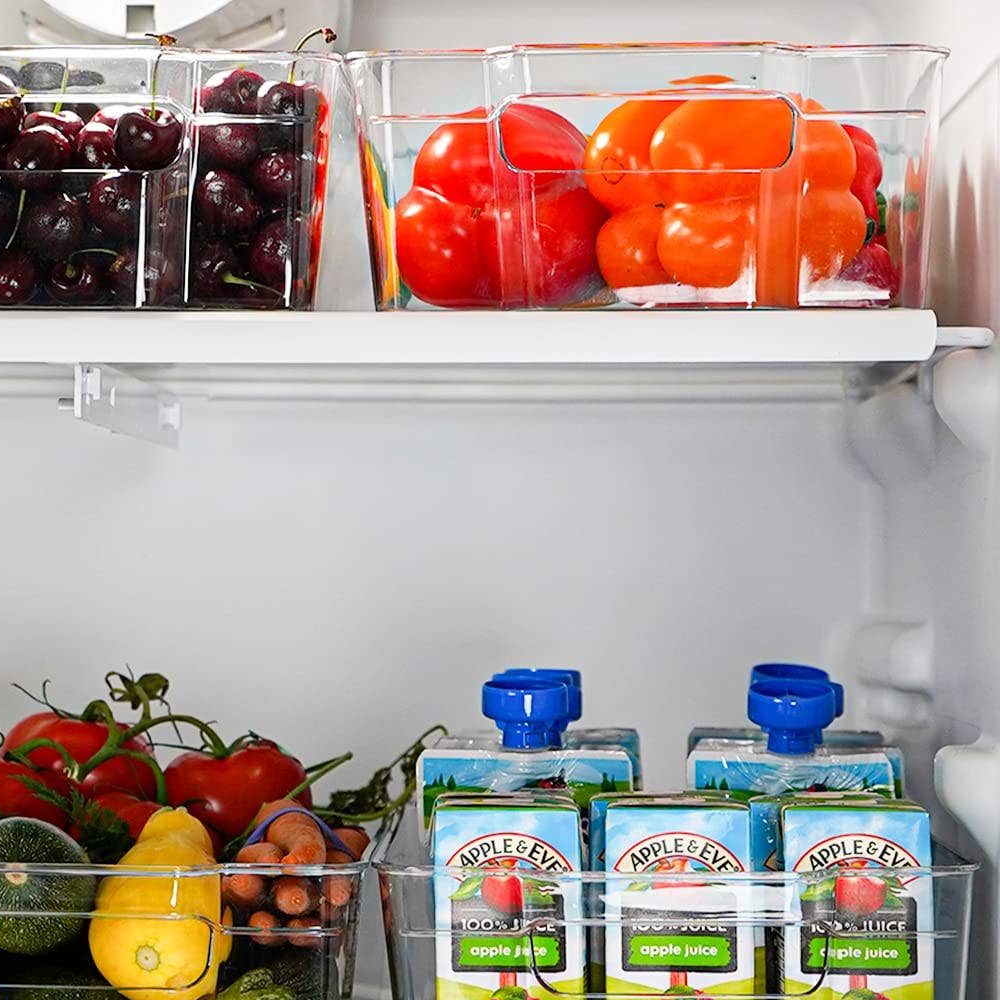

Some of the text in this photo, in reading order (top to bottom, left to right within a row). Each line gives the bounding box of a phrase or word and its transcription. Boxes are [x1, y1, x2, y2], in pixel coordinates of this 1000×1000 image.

[460, 838, 513, 868] APPLE
[516, 839, 528, 853] &
[630, 838, 734, 872] APPLE & EVE
[809, 840, 863, 871] APPLE
[866, 841, 878, 855] &
[461, 918, 507, 931] 100%
[858, 920, 907, 933] JUICE
[470, 945, 548, 958] apple jce
[640, 944, 718, 958] apple juice
[820, 947, 899, 960] aple juice
